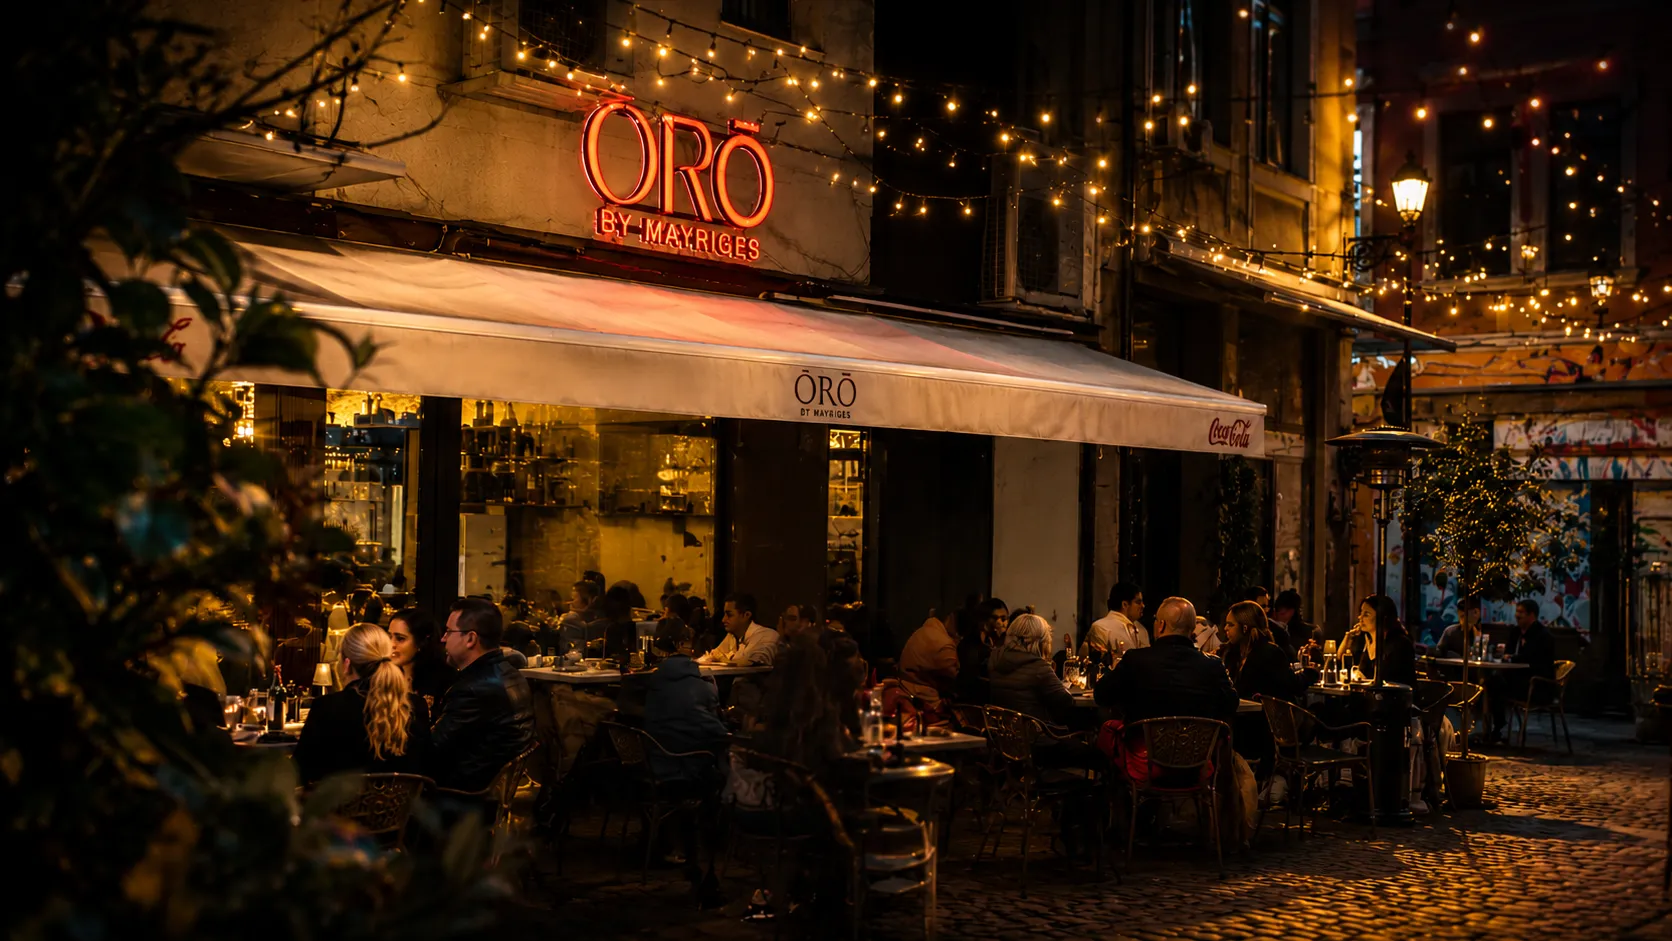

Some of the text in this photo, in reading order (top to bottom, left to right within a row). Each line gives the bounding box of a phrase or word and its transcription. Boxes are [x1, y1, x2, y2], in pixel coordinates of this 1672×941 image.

[596, 207, 760, 261] BY MAYRIGES
[794, 369, 857, 408] ŌRŌ
[814, 409, 851, 418] MAYRIGES
